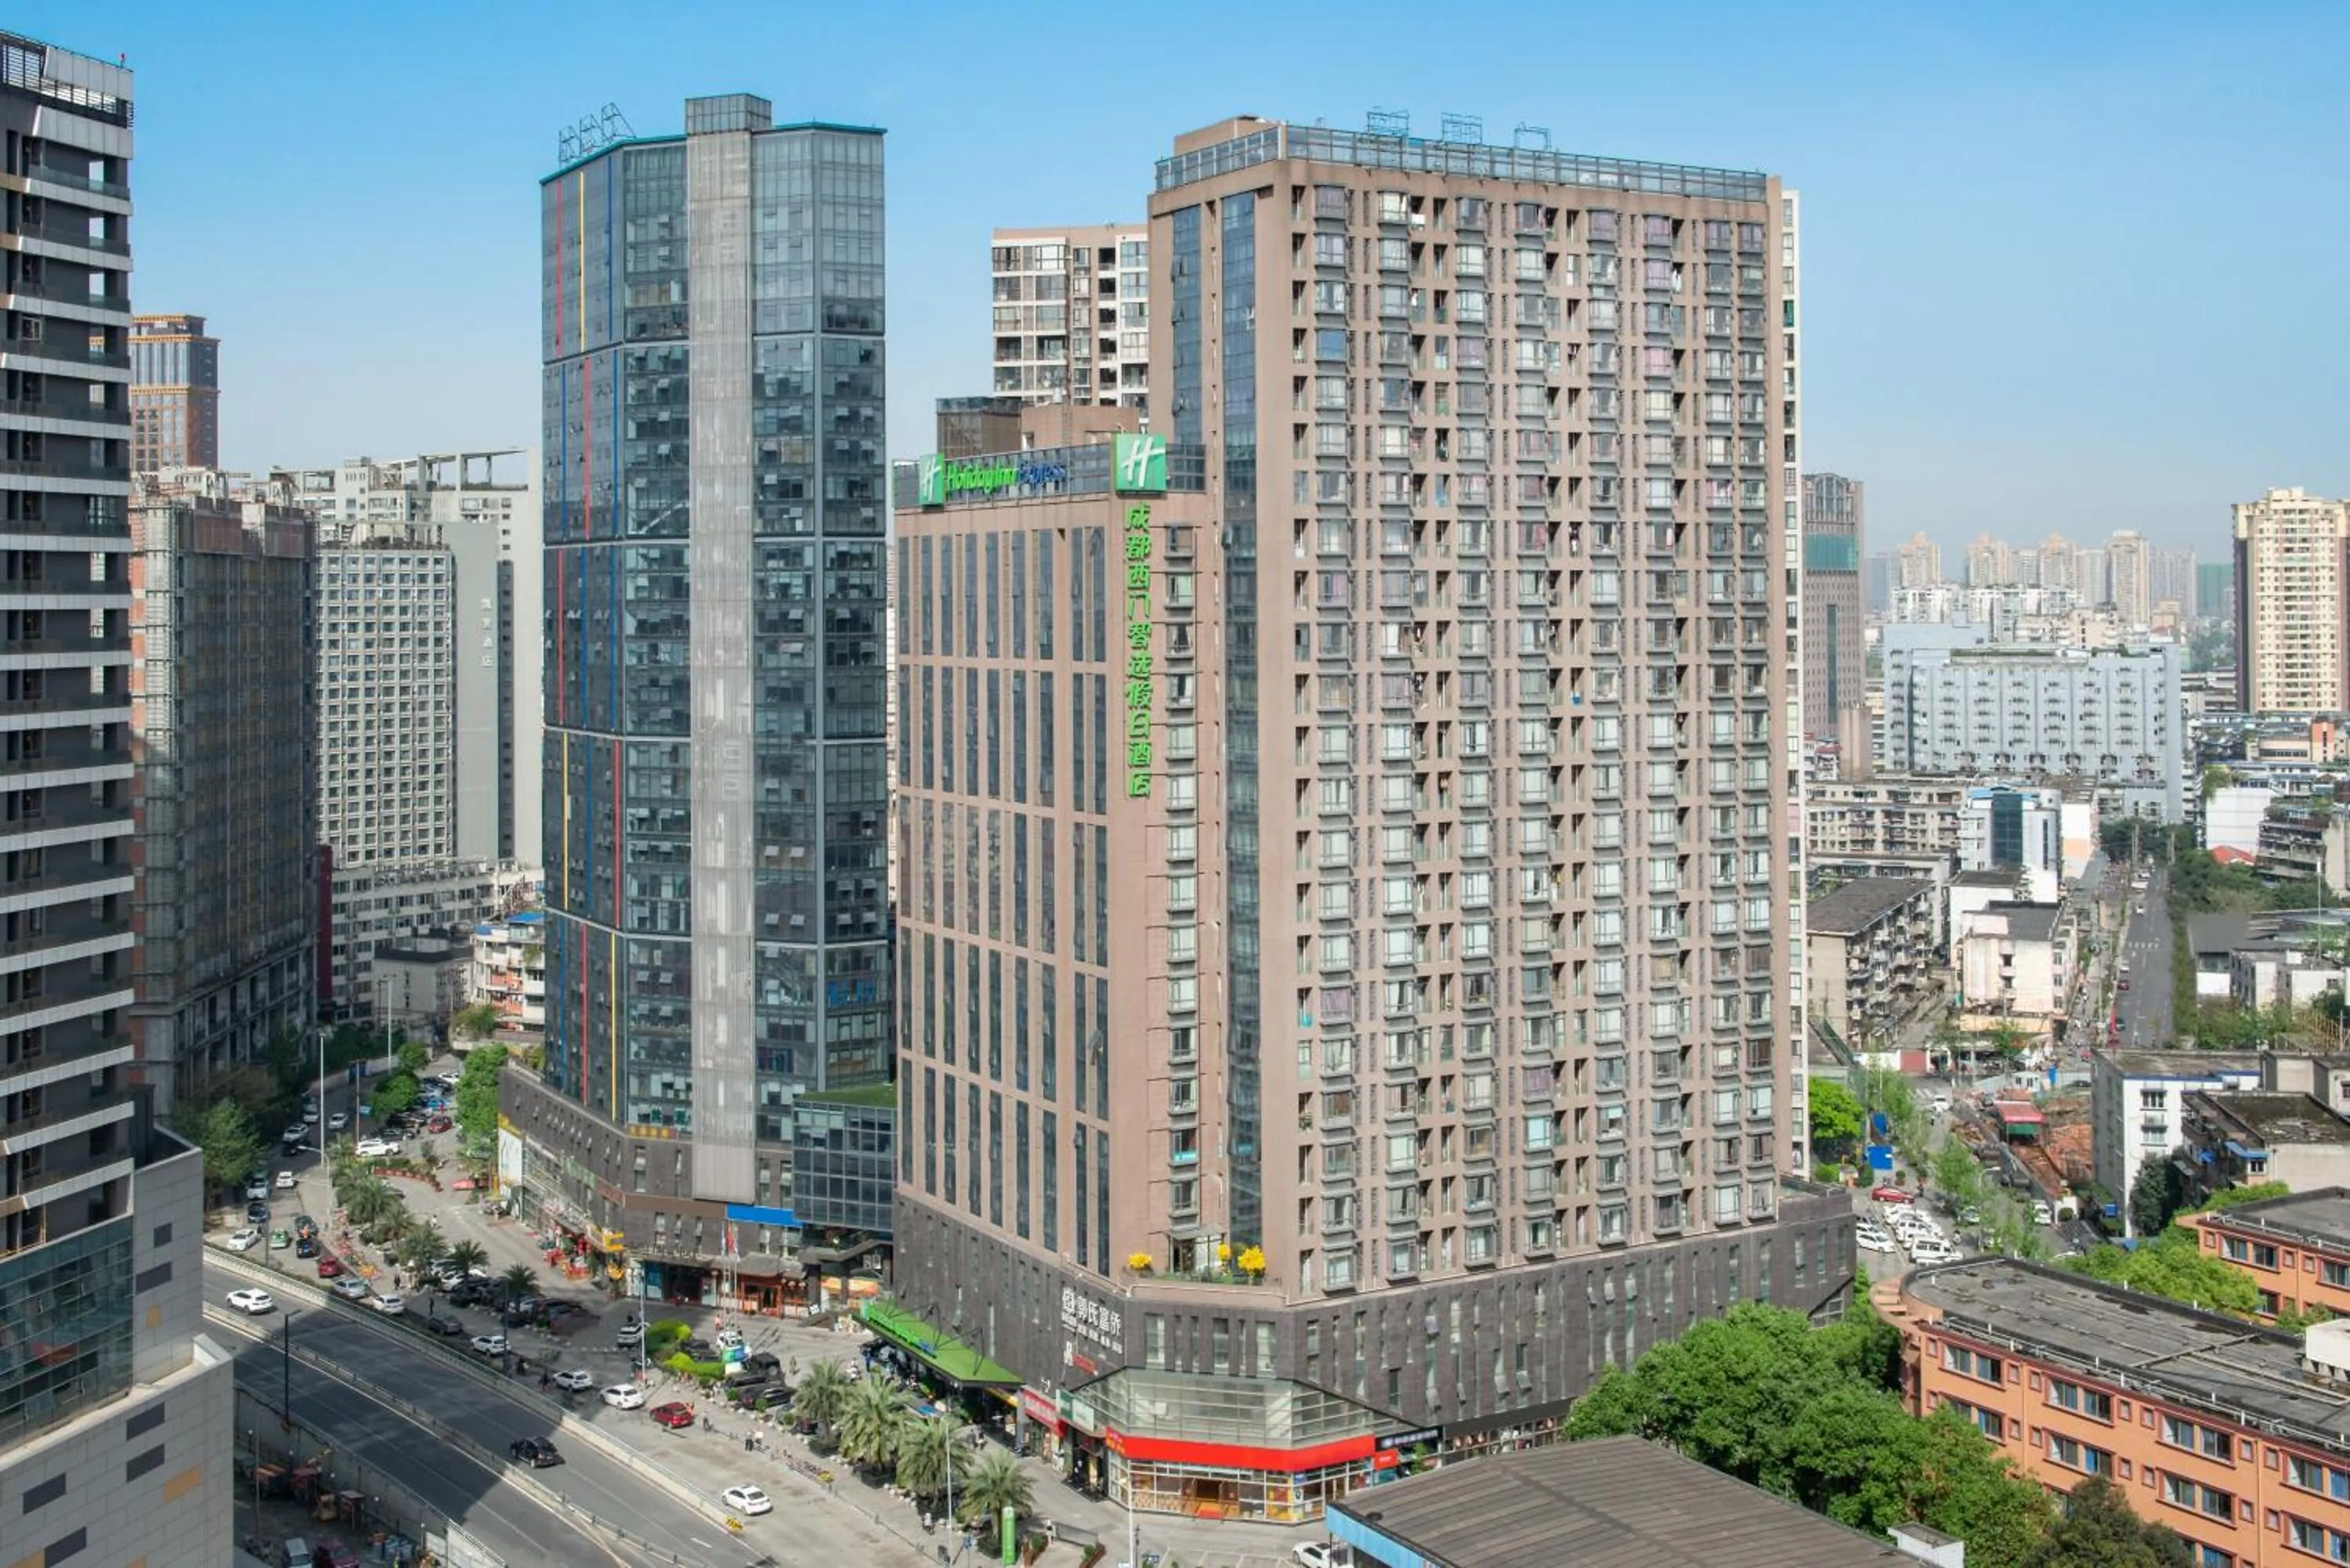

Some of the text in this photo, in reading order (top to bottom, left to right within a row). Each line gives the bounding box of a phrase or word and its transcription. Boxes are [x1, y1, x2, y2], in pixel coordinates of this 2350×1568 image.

[1126, 501, 1152, 798] 成都西门智选假日酒店
